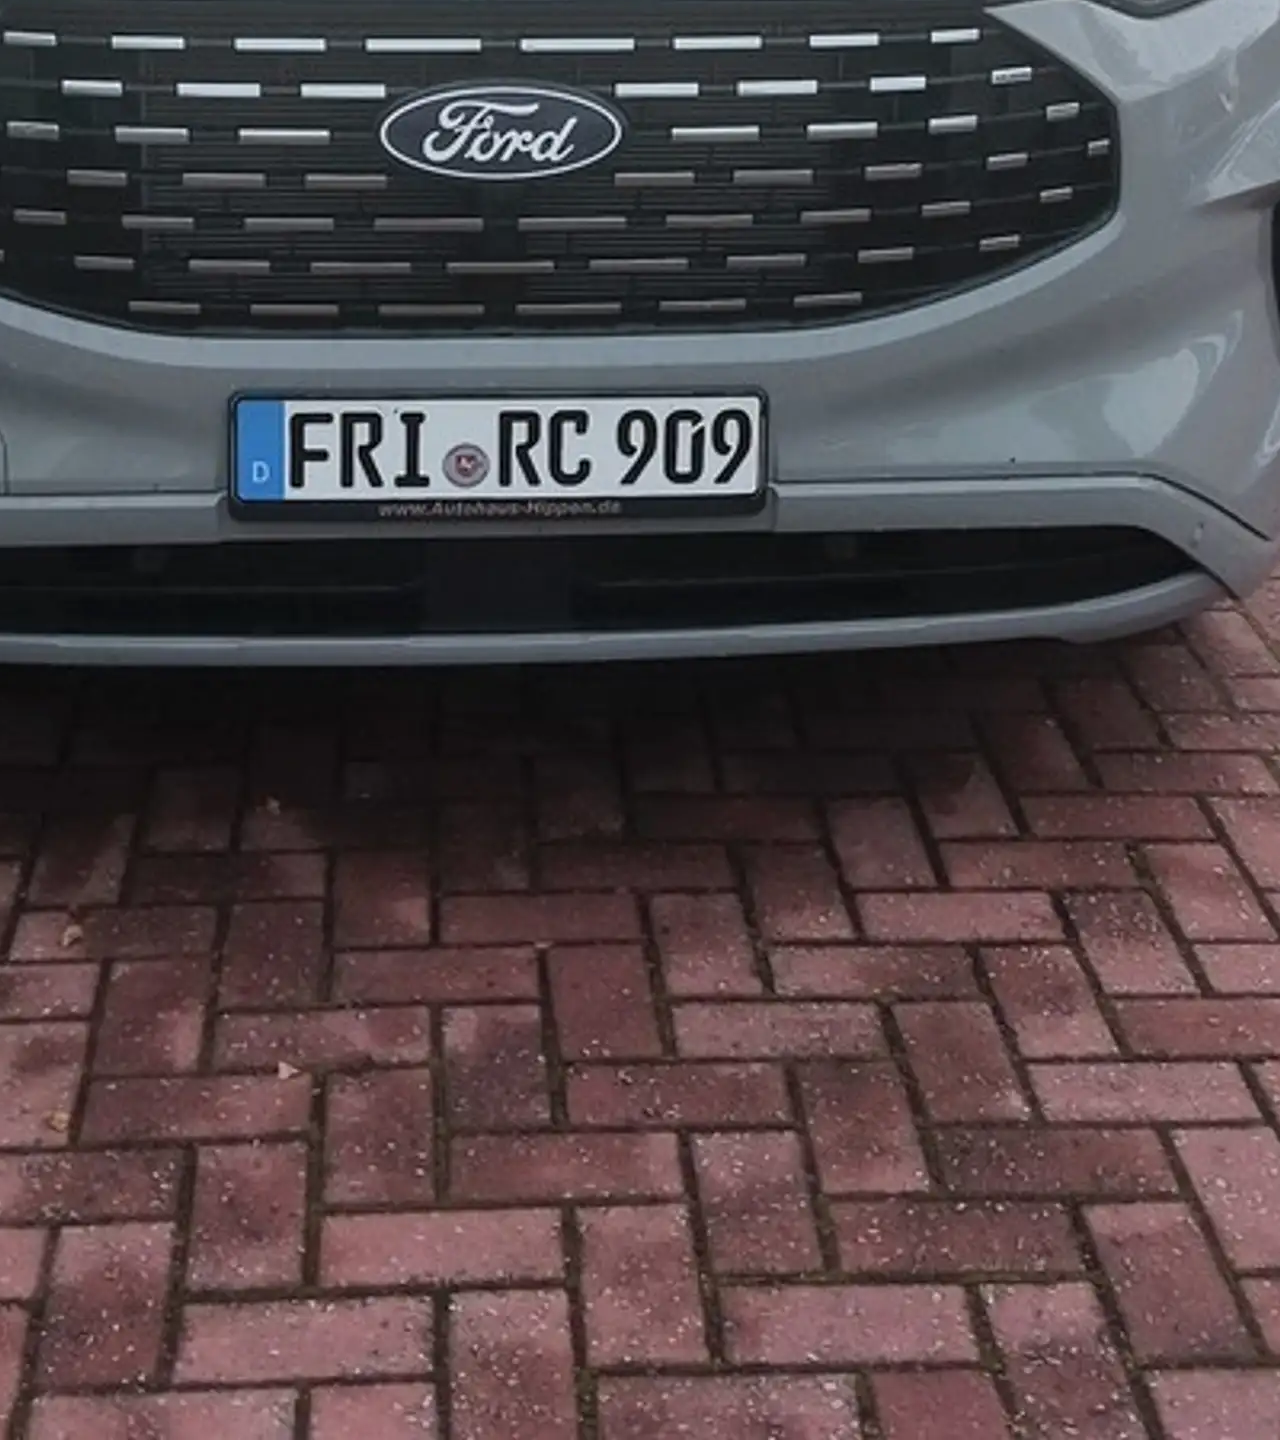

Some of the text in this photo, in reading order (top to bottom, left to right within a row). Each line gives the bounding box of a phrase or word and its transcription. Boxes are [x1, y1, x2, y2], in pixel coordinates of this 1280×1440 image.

[422, 99, 578, 162] Ford
[251, 408, 753, 488] D FRI RC 909
